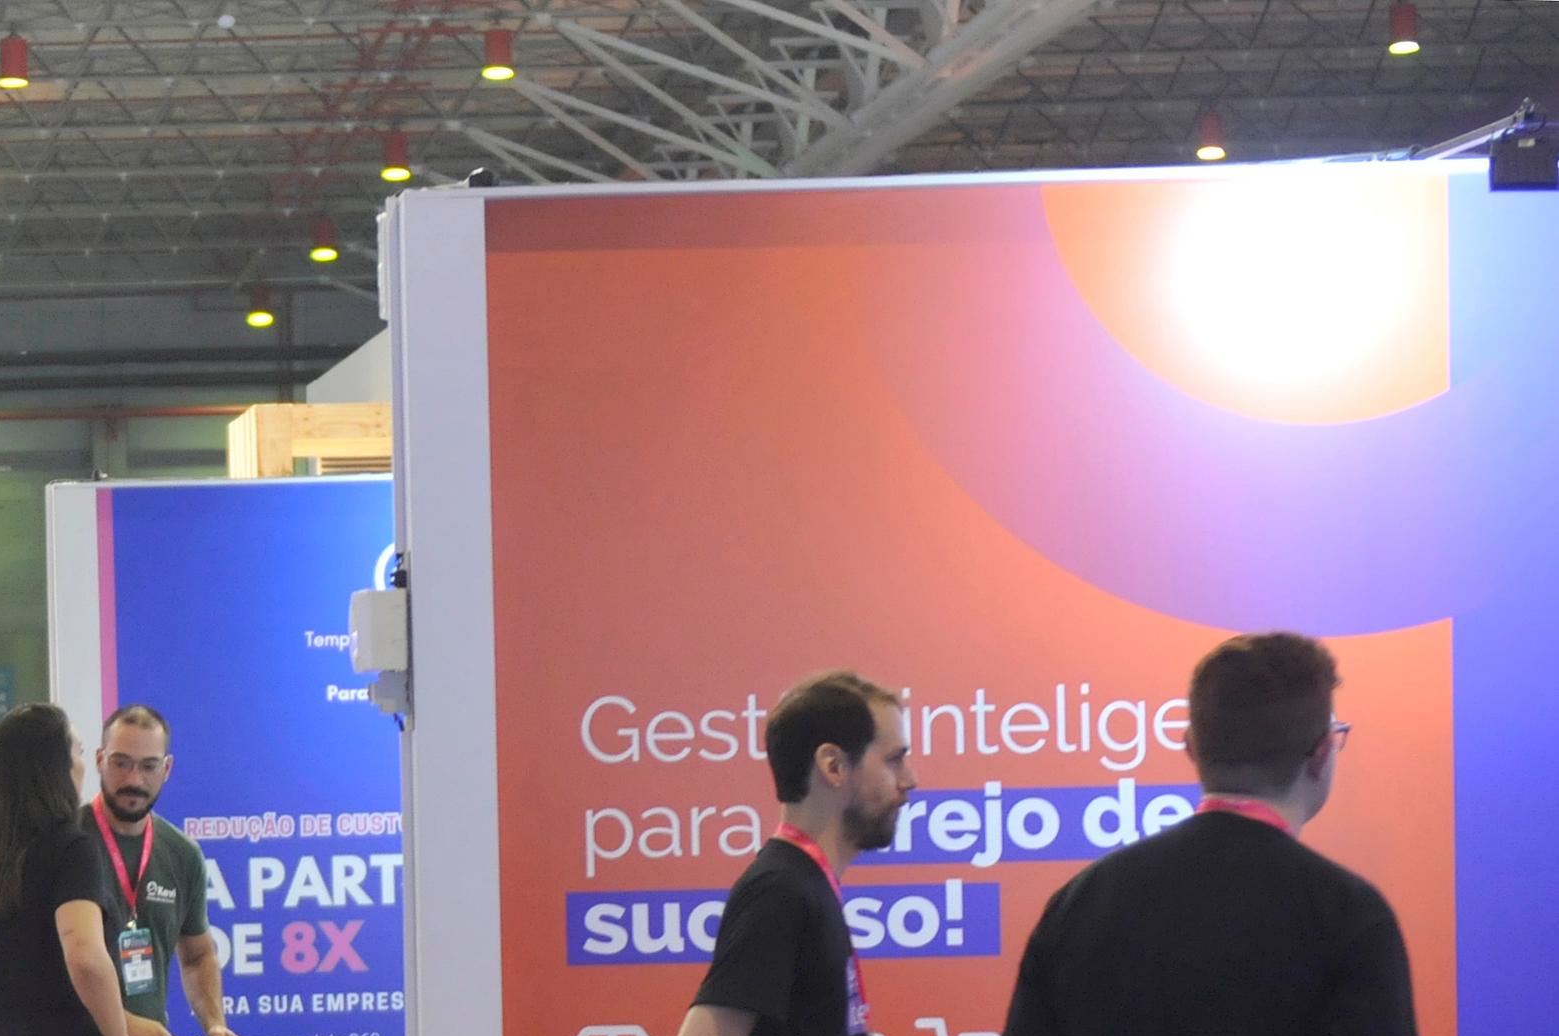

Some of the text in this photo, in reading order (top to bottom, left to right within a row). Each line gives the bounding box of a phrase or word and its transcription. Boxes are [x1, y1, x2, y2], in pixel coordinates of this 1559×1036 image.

[185, 812, 403, 842] REDUÇÃO DE CUST
[585, 778, 1195, 878] para rejo de
[280, 920, 369, 974] 8X
[258, 994, 304, 1014] SUA
